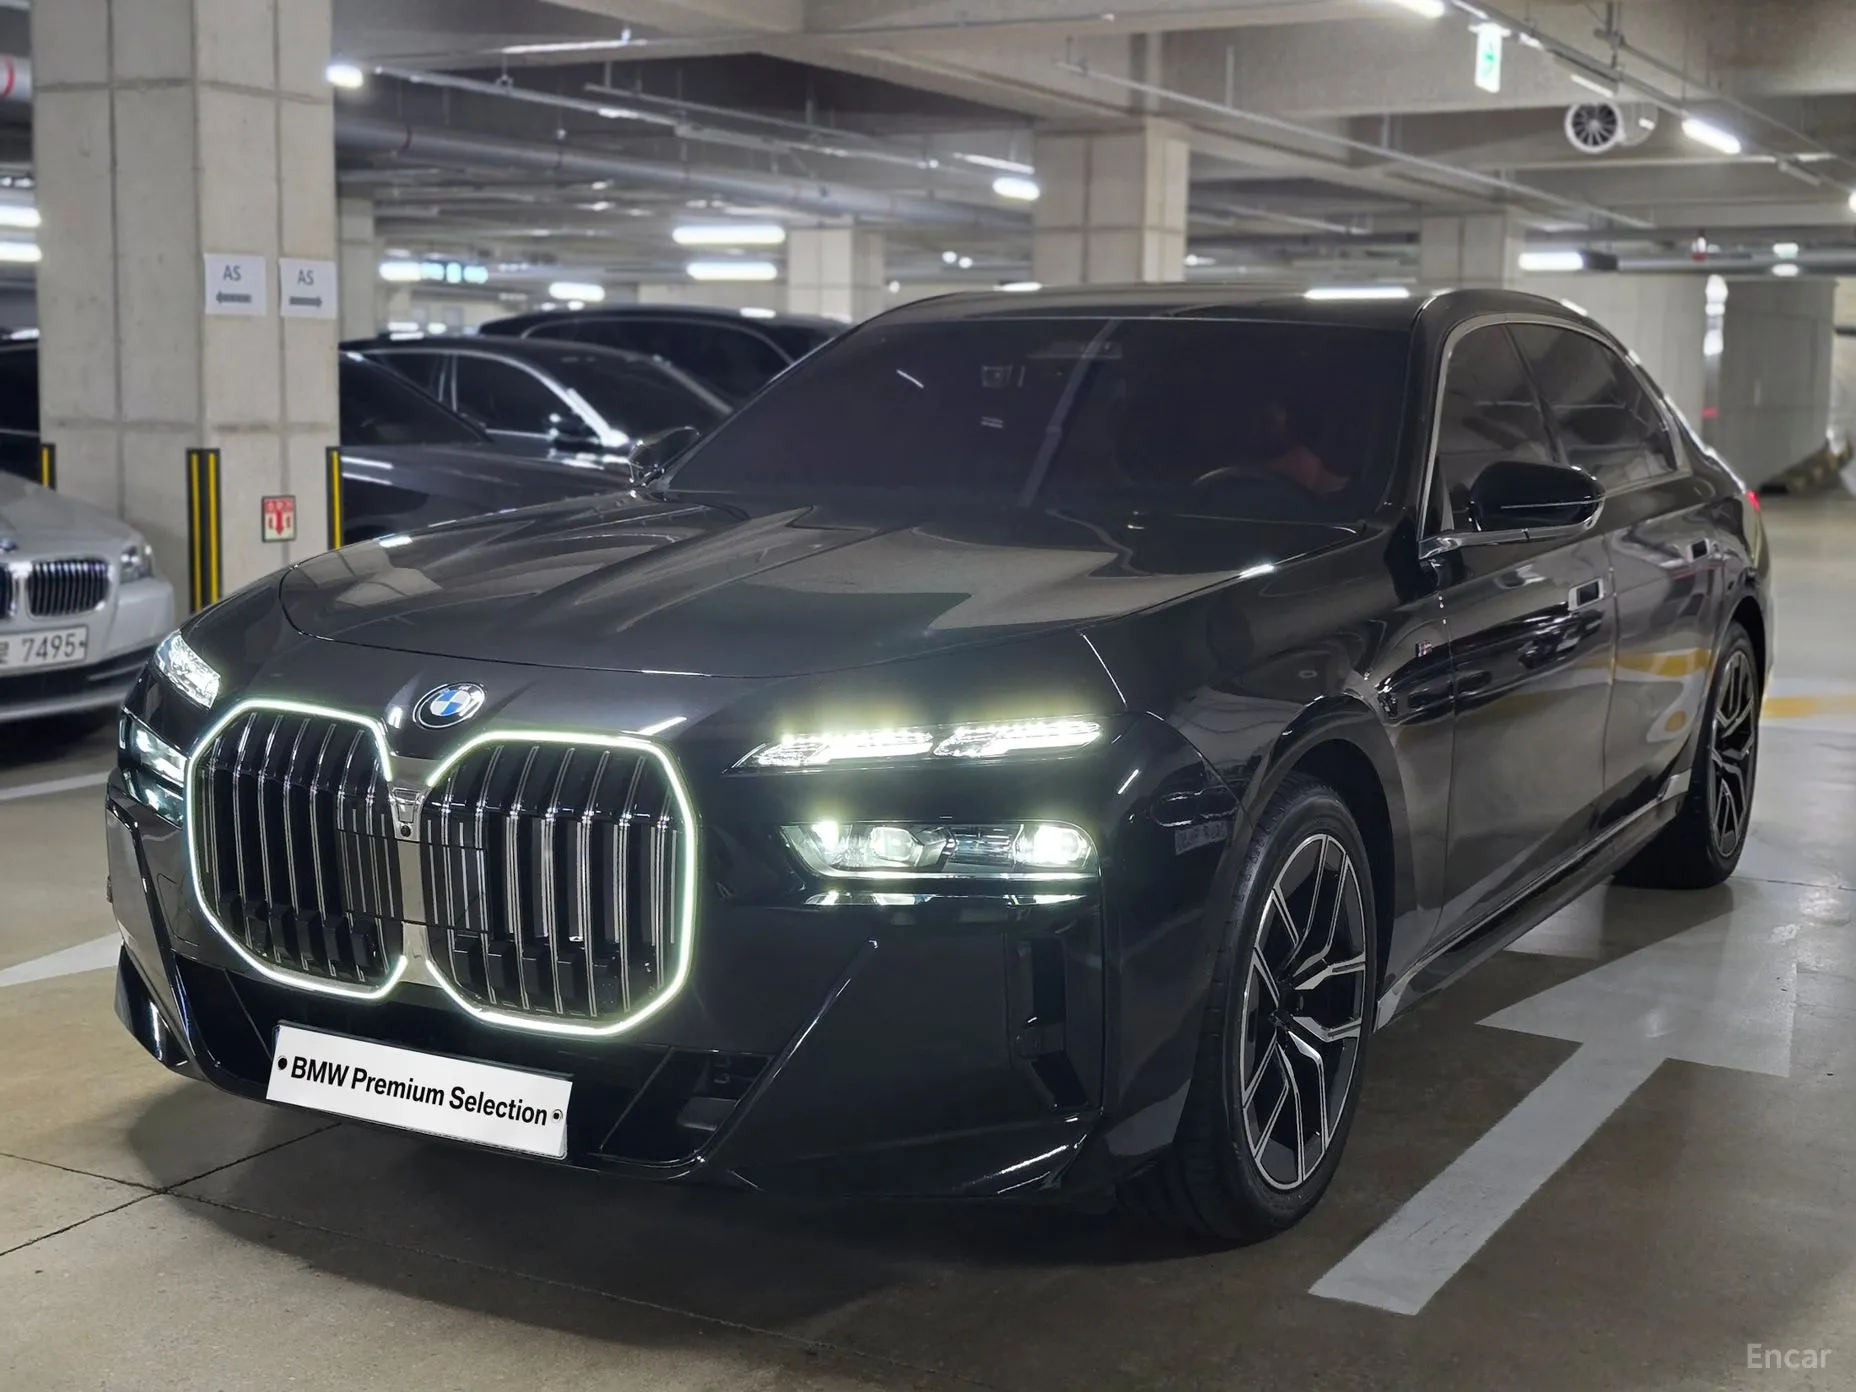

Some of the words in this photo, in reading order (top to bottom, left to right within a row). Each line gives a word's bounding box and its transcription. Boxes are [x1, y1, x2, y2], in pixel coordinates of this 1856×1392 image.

[223, 264, 242, 282] AS
[297, 268, 314, 286] AS
[21, 632, 76, 663] 7495
[290, 1055, 350, 1088] BMW
[350, 1066, 445, 1106] Premium
[448, 1085, 548, 1126] Selection
